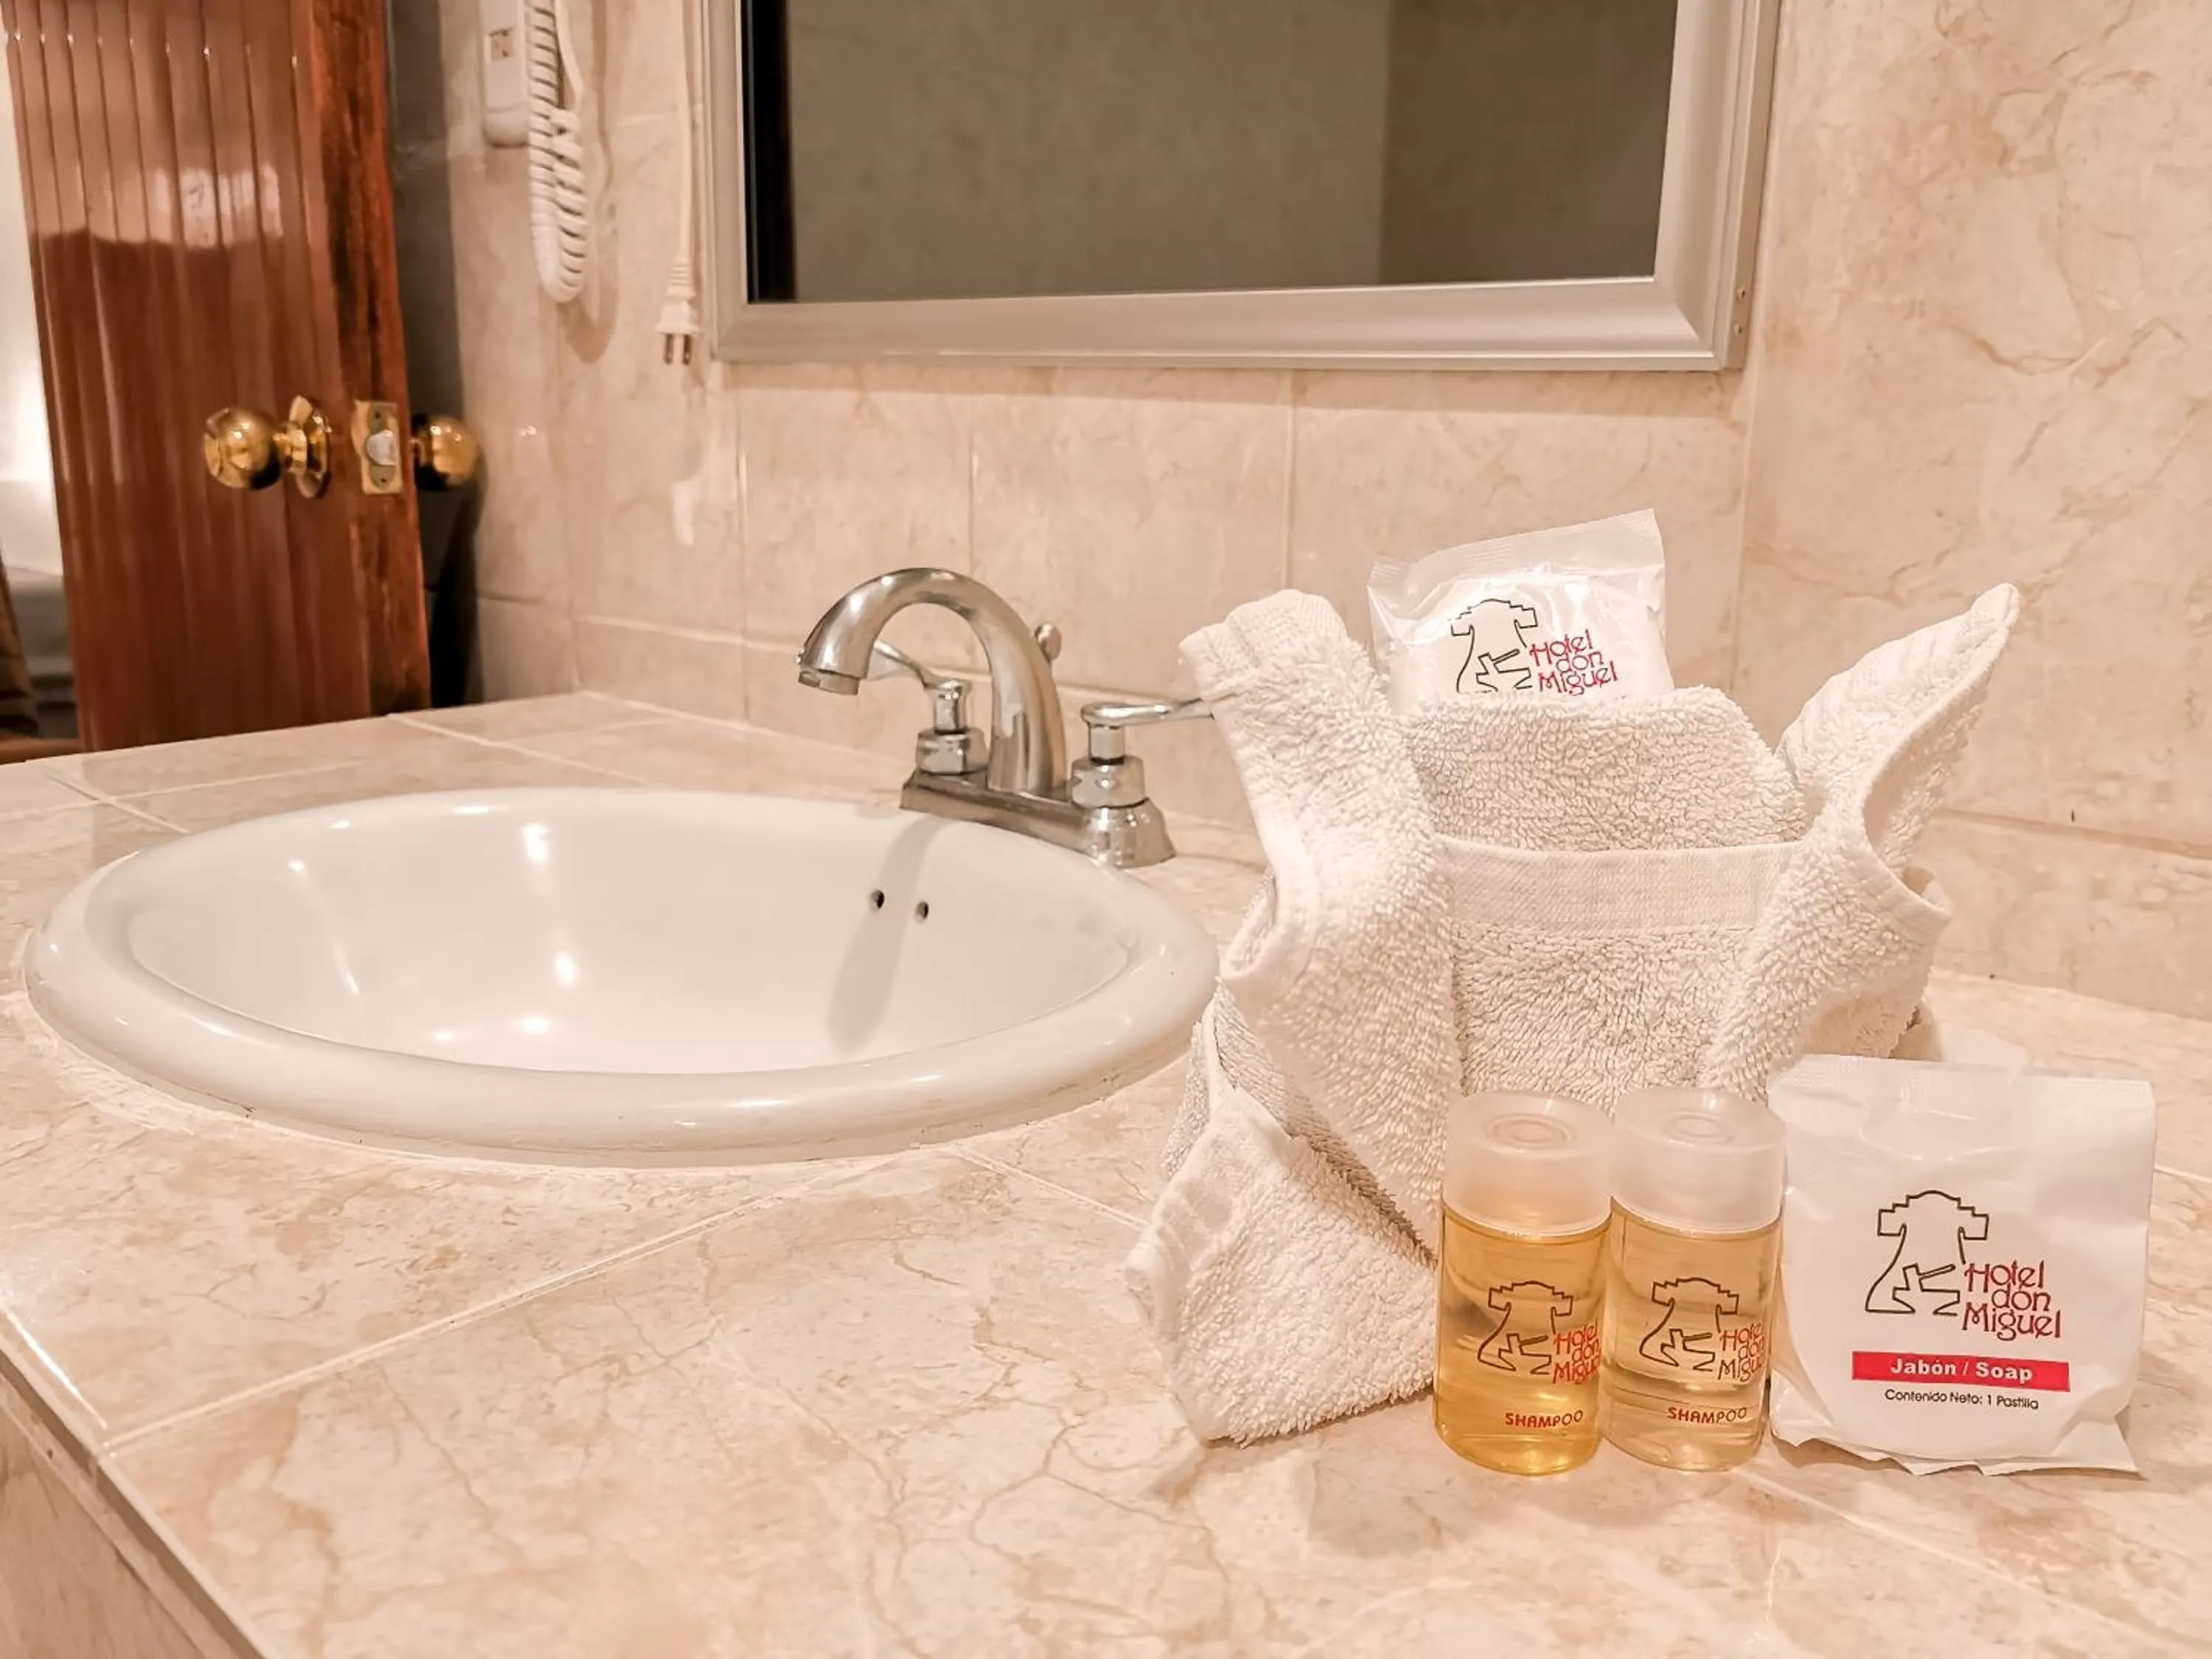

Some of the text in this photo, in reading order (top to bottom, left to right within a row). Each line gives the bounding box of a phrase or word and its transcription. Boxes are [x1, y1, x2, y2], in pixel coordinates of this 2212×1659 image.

[1529, 629, 1593, 667] Hotel
[1555, 651, 1604, 672] don
[1538, 661, 1618, 696] Miguel
[1964, 1260, 2045, 1293] Hotel
[1991, 1283, 2051, 1312] don
[1962, 1301, 2062, 1341] Miguel
[1890, 1358, 1956, 1375] Jabón
[1975, 1362, 2034, 1383] Soap
[1884, 1388, 2039, 1410] Contenido Neto: 1 Pastilla
[1505, 1410, 1583, 1428] SHAMPOO
[1667, 1408, 1747, 1424] SHAMPOO
